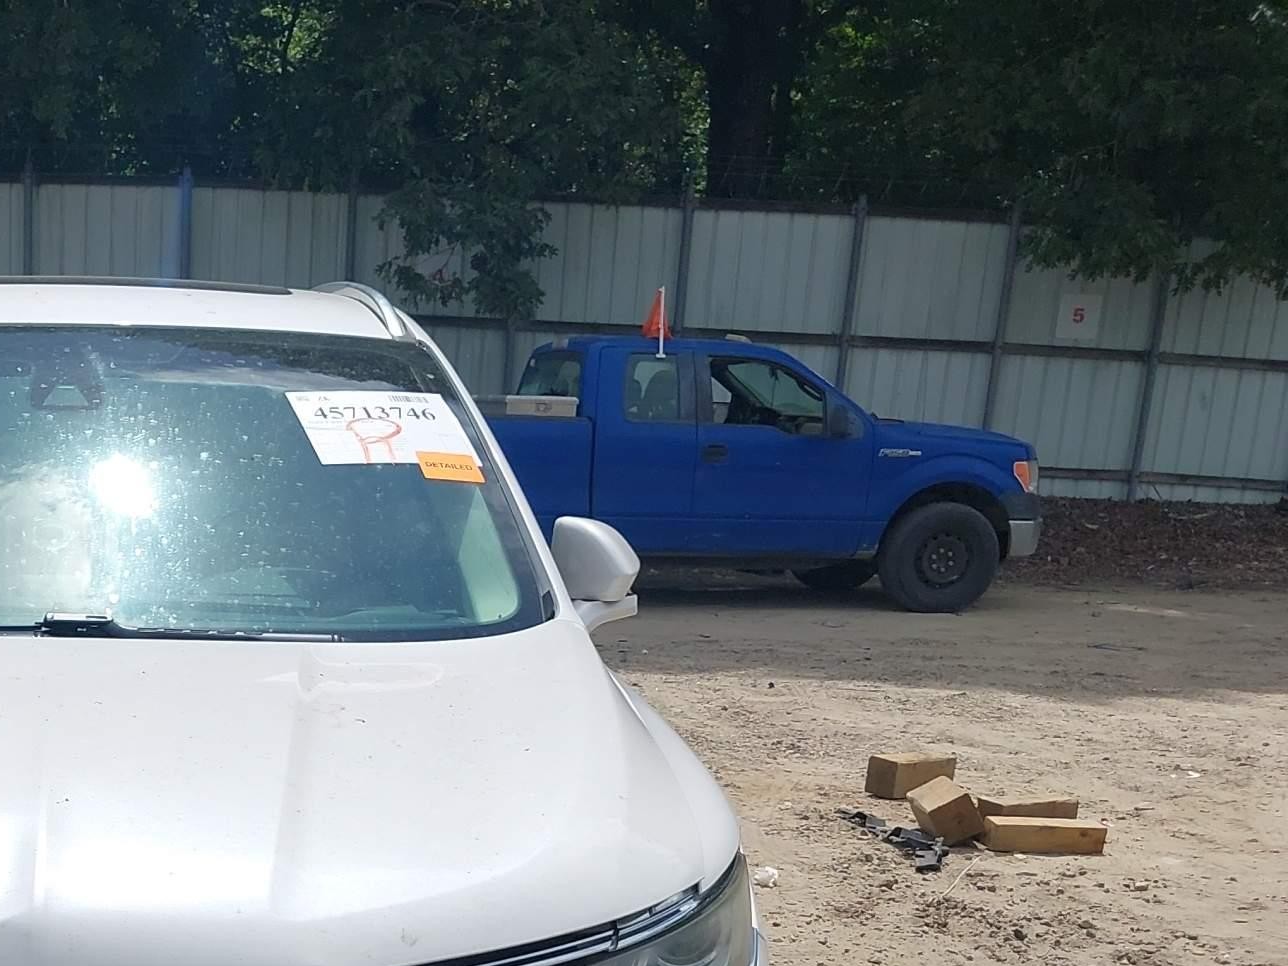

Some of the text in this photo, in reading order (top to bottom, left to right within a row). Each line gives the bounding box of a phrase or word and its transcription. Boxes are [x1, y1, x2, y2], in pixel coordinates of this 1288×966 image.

[1072, 308, 1085, 324] 5
[314, 406, 436, 421] 45713746
[424, 461, 473, 471] DETAILED
